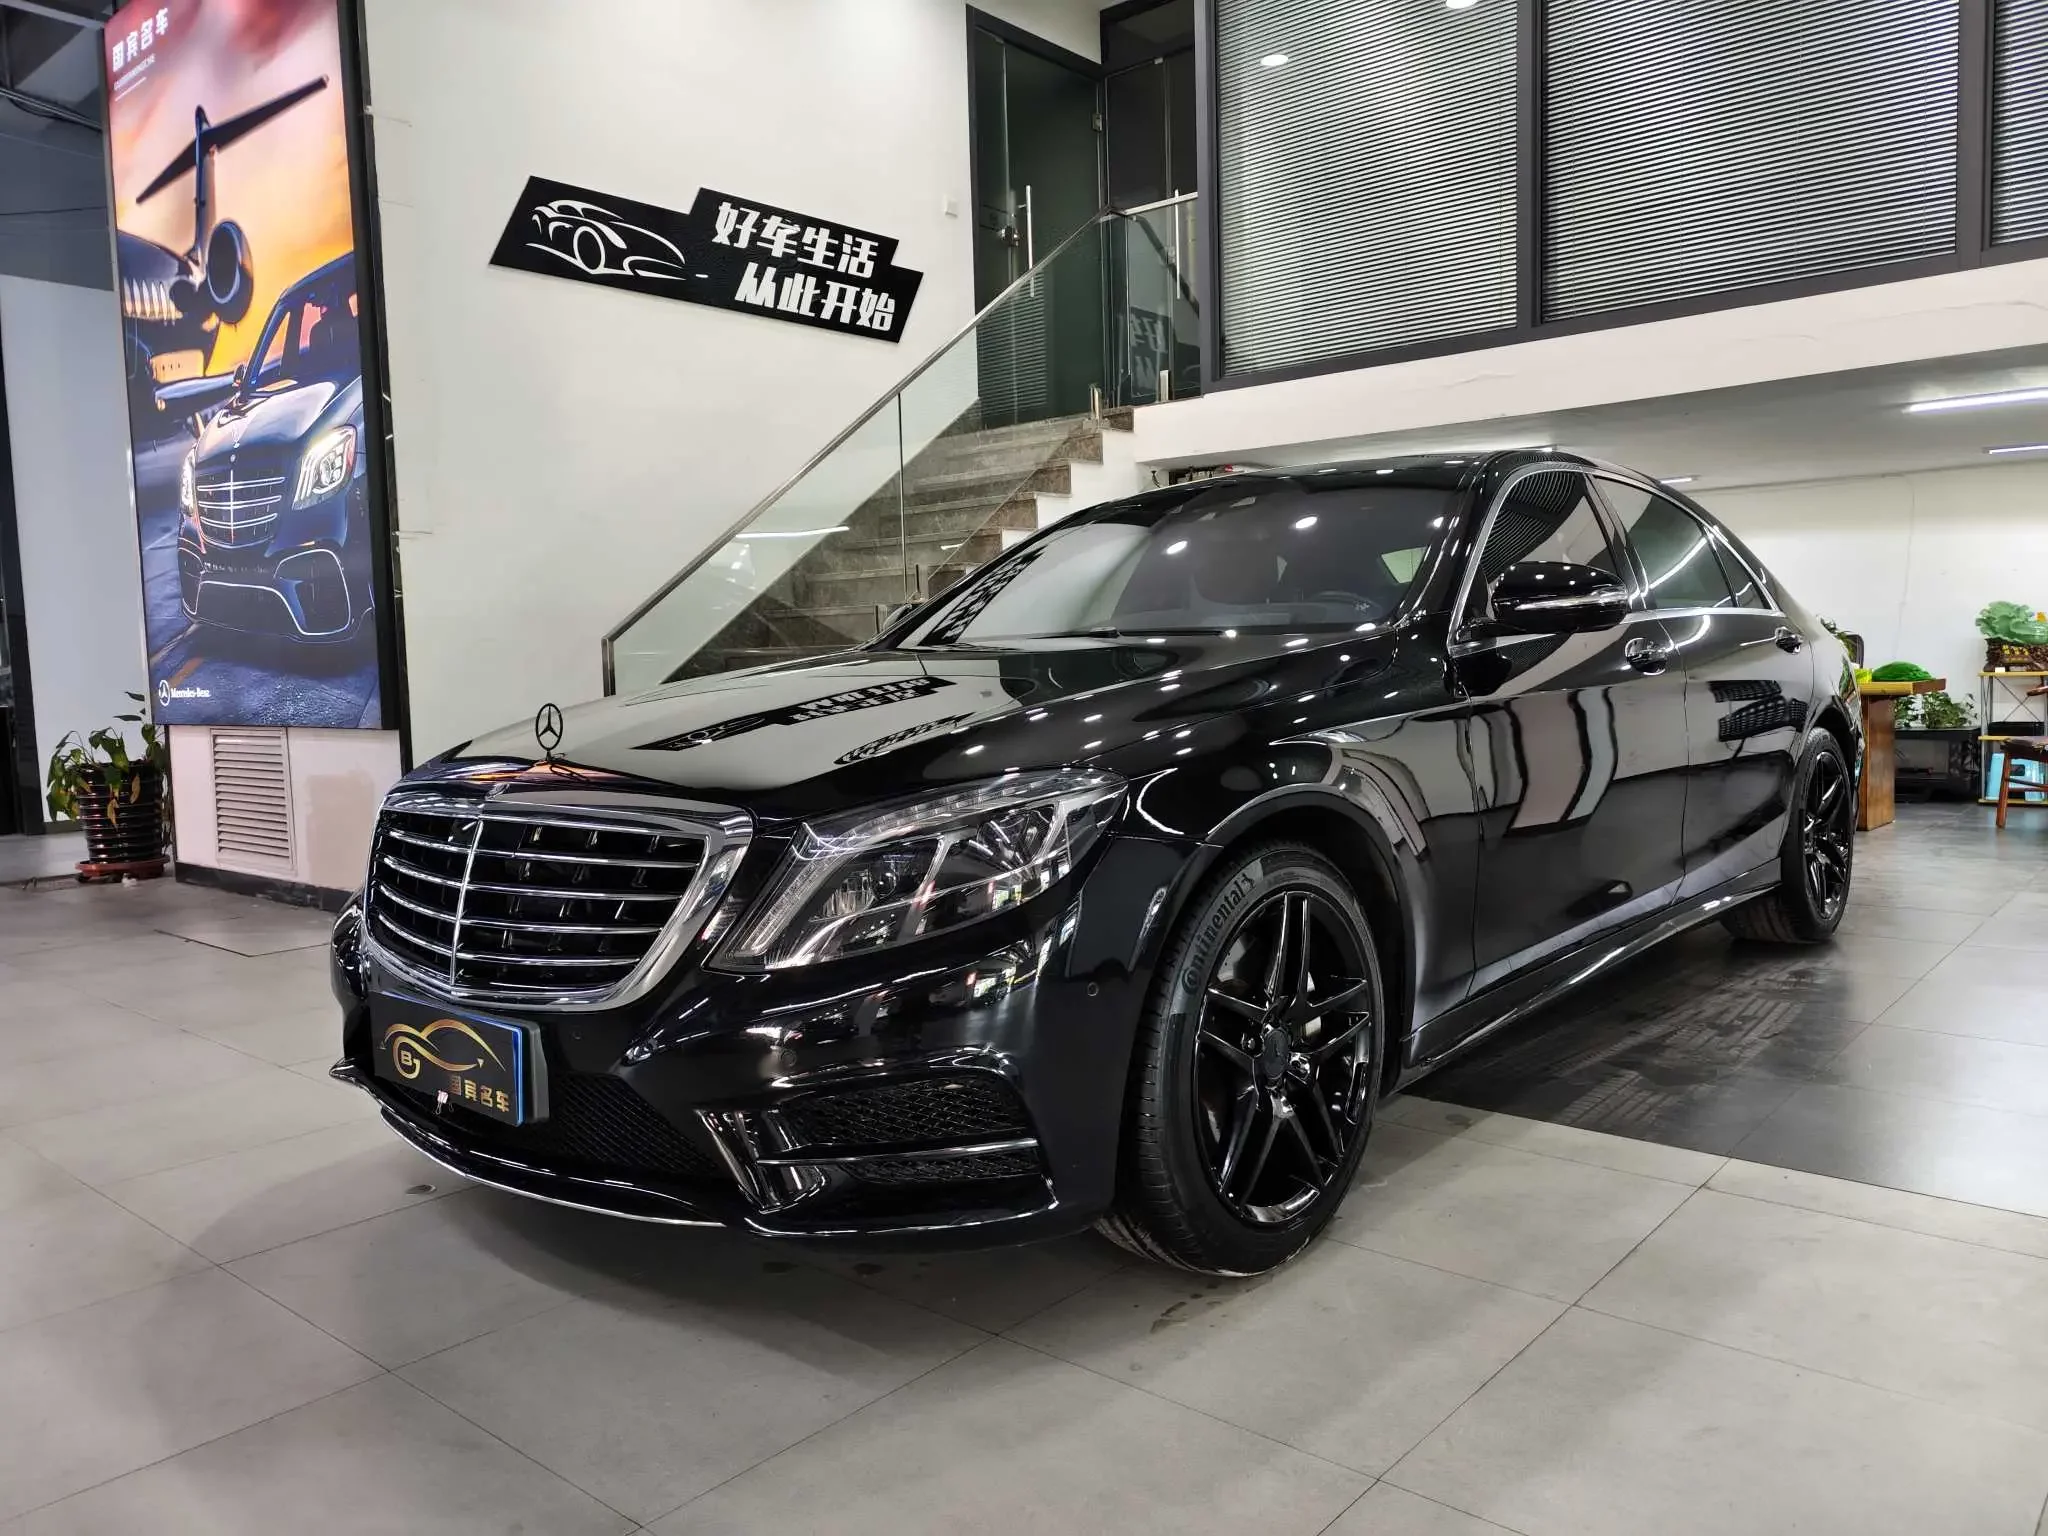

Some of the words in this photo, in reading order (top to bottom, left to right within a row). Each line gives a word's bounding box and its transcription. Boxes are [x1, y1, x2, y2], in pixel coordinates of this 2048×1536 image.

[711, 202, 879, 279] 好车生活
[734, 261, 896, 332] 从此开始
